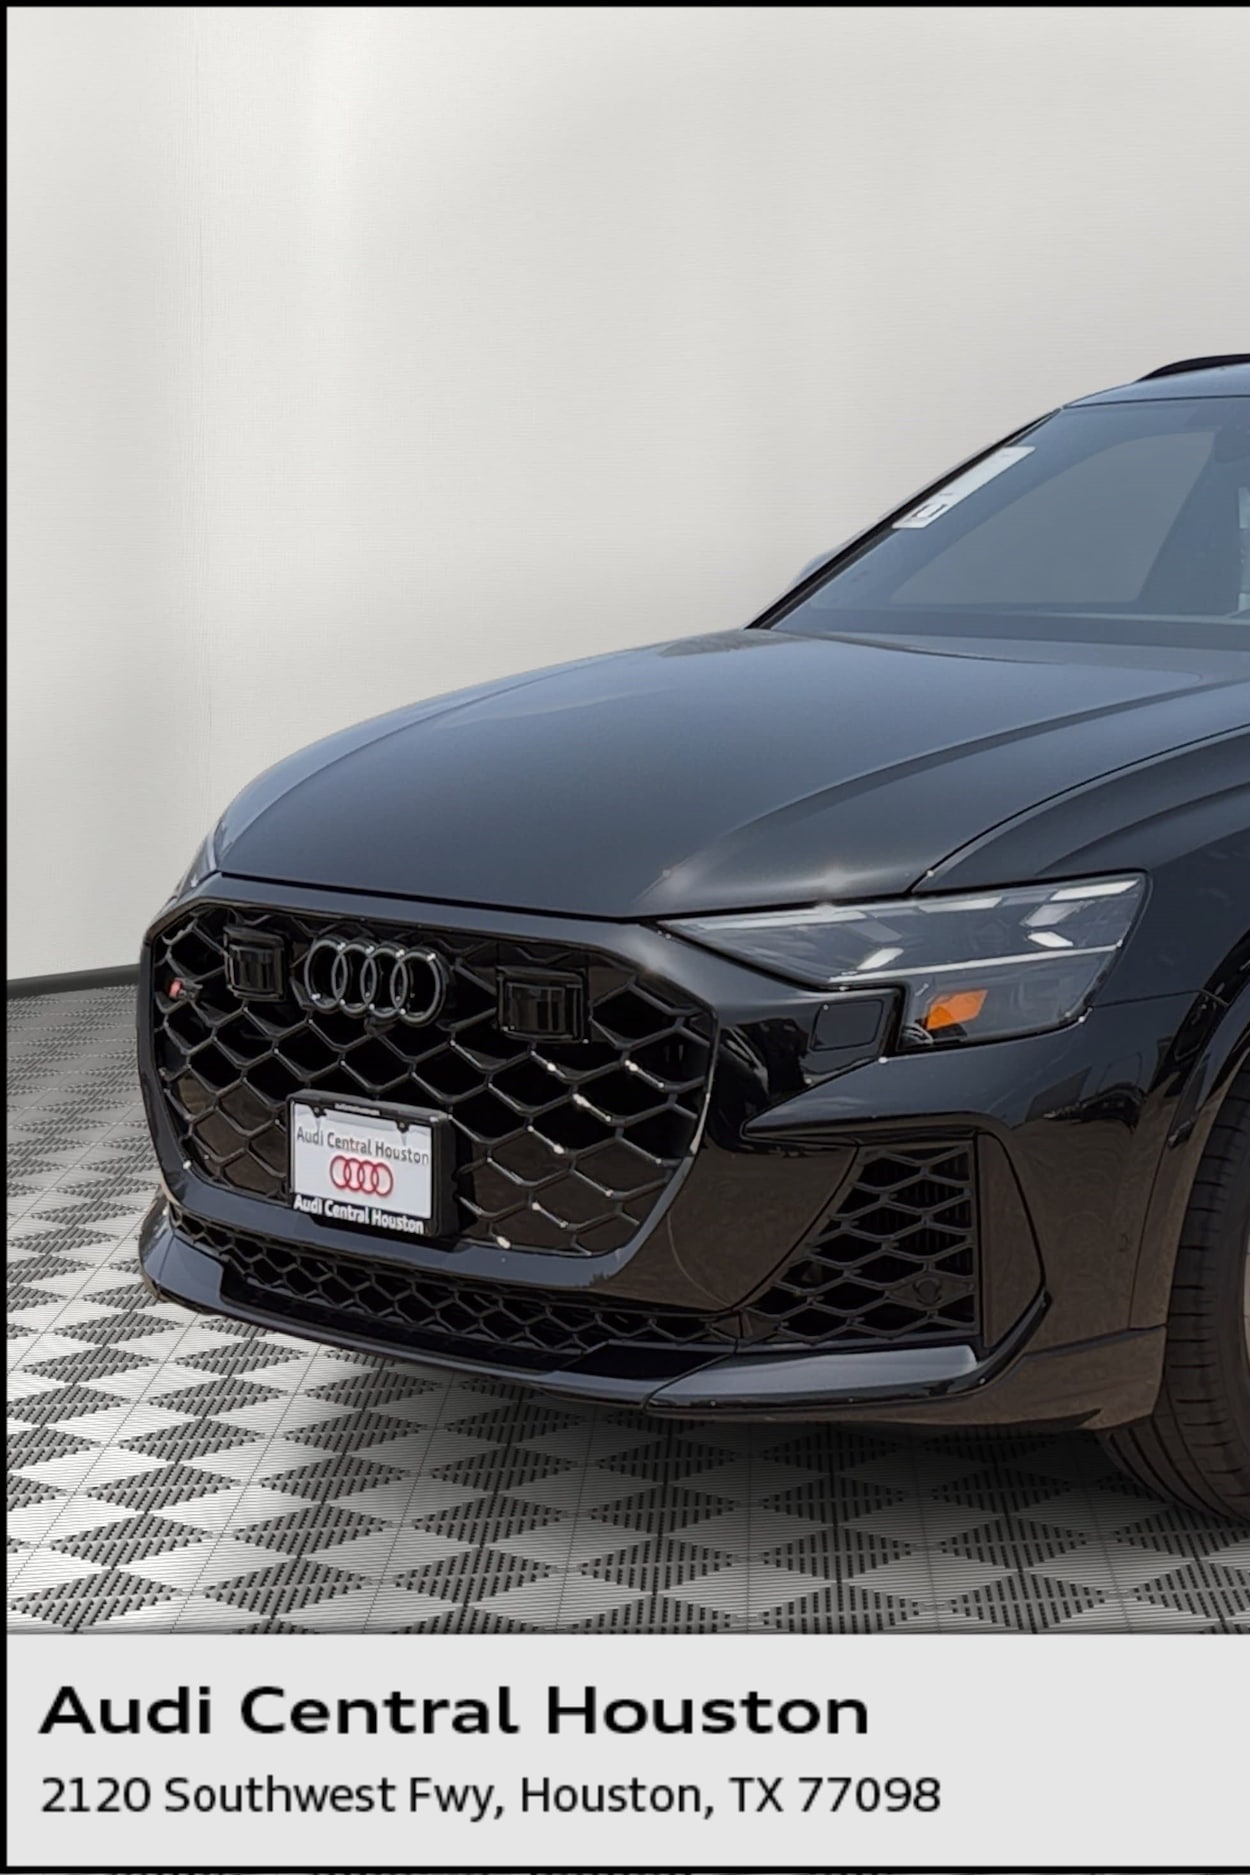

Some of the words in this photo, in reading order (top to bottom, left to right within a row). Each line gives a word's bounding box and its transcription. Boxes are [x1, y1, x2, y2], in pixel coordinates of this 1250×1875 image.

[297, 1126, 324, 1146] Audi
[327, 1132, 372, 1155] Central
[375, 1141, 429, 1165] Houston
[294, 1195, 322, 1215] Audi
[325, 1200, 369, 1224] Central
[372, 1210, 424, 1234] Houston
